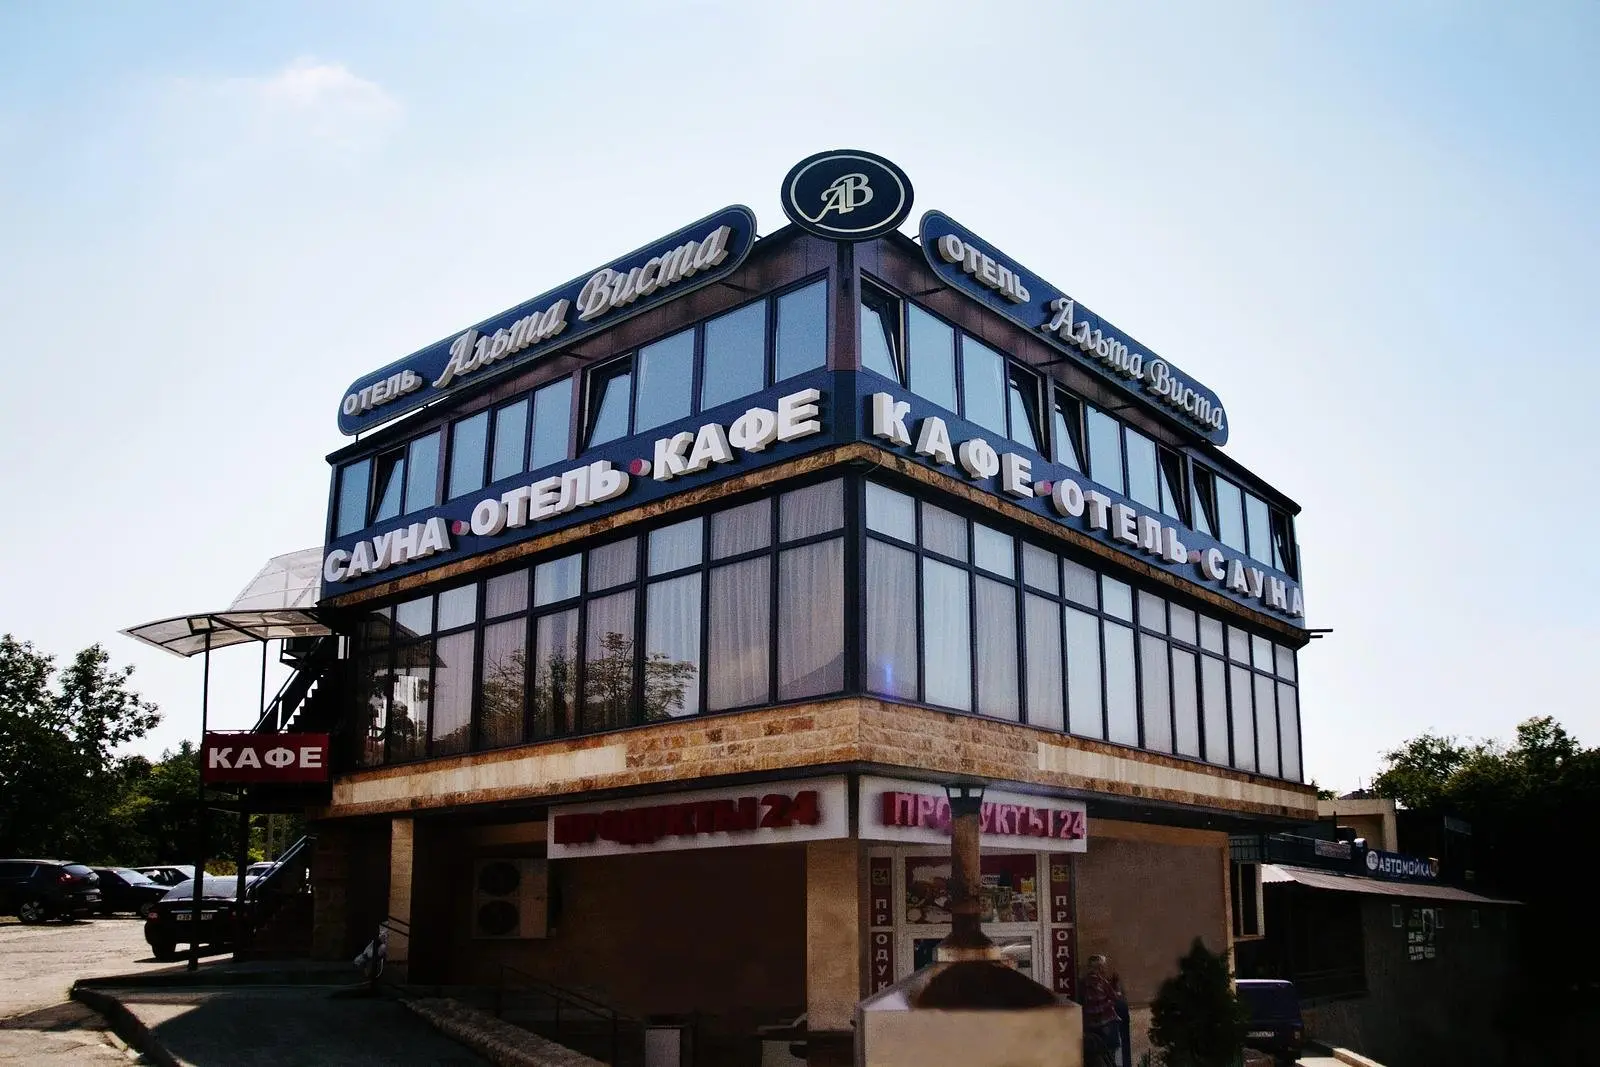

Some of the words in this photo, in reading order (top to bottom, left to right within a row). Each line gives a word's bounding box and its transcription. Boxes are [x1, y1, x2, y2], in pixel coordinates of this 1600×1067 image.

[342, 368, 423, 416] ОТЕЛЬ
[432, 299, 570, 388] Альта
[576, 224, 733, 321] Виста
[937, 233, 1031, 305] ОТЕЛЬ
[1041, 297, 1145, 382] Альта
[1149, 358, 1225, 433] Виста
[323, 517, 451, 583] САУНА
[470, 460, 630, 536] ОТЕЛЬ
[653, 388, 820, 481] КАФЕ
[872, 391, 1034, 499] КАФЕ
[1050, 478, 1188, 565] ОТЕЛЬ
[1200, 547, 1304, 618] САУНА
[207, 746, 323, 769] КАФЕ
[759, 790, 819, 829] 24
[883, 791, 1054, 837] ПРОУКТЫ
[1058, 811, 1086, 839] 24
[1378, 856, 1431, 878] АВТОМОЙКА
